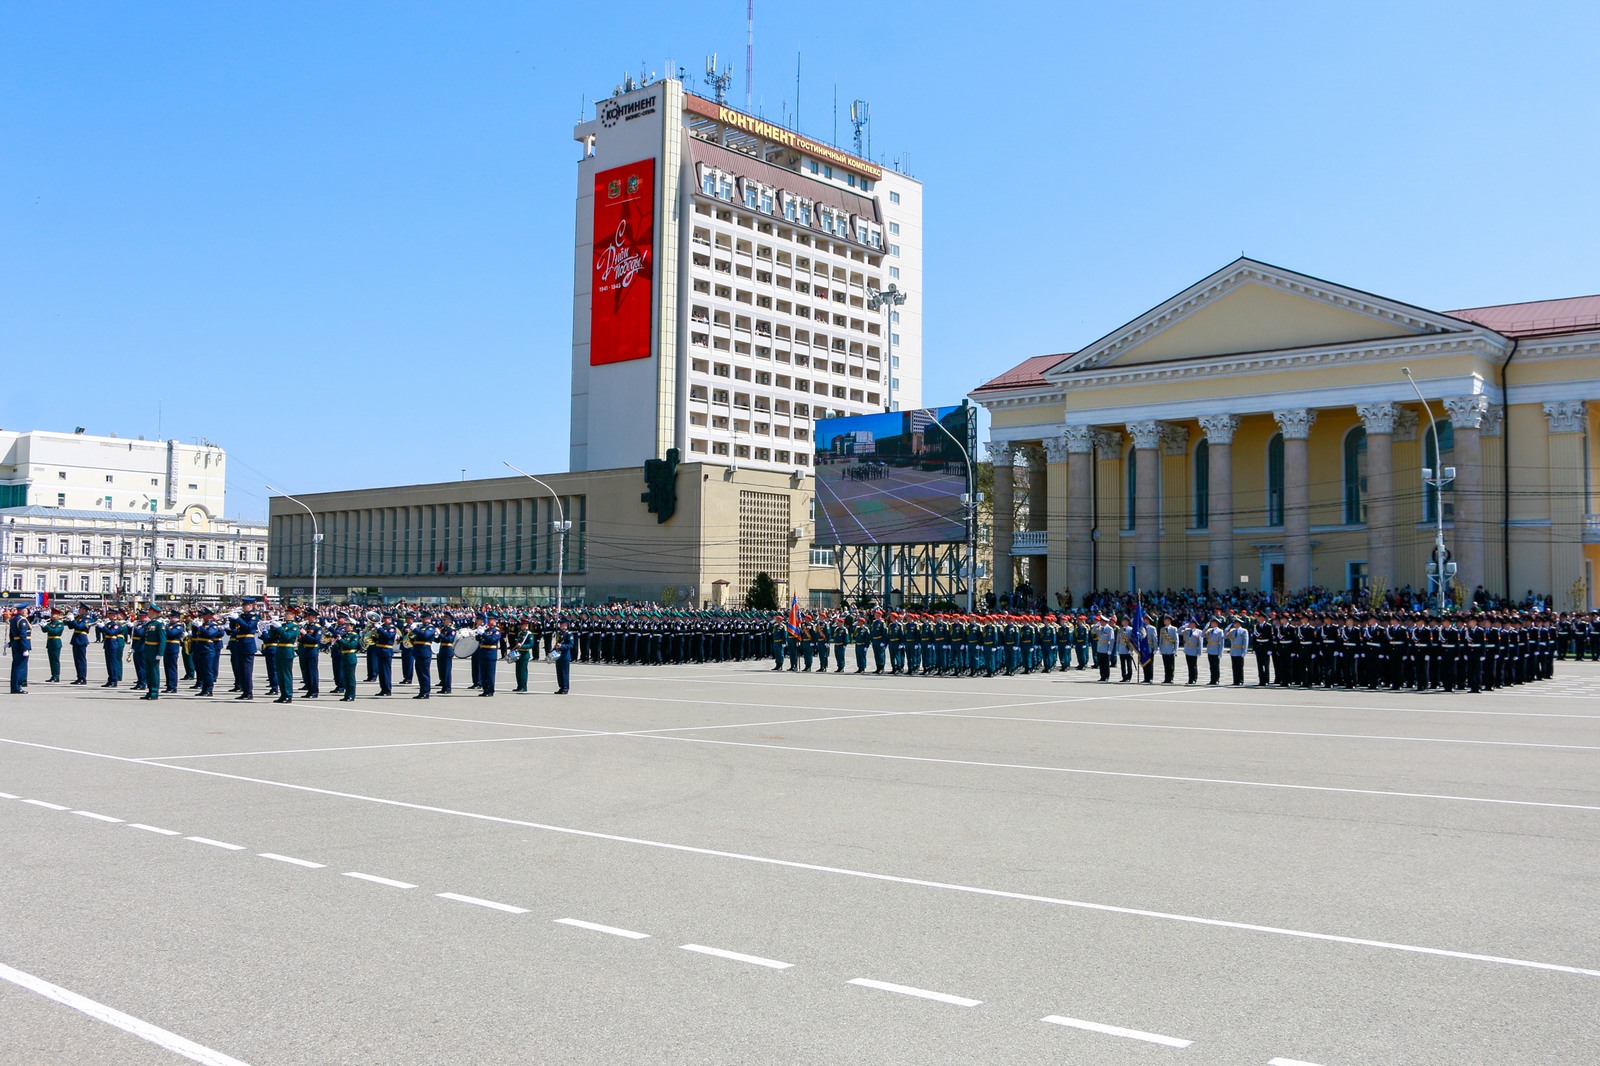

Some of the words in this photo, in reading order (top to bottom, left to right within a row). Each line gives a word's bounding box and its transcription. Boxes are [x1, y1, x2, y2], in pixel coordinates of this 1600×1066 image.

[606, 96, 656, 120] КОНТИНЕНТ
[719, 106, 795, 146] КОНТИНЕНТ
[796, 139, 847, 164] ГОСТИНИЧНЫЙ
[847, 158, 881, 176] КОМПЛЕКС
[615, 219, 626, 247] С
